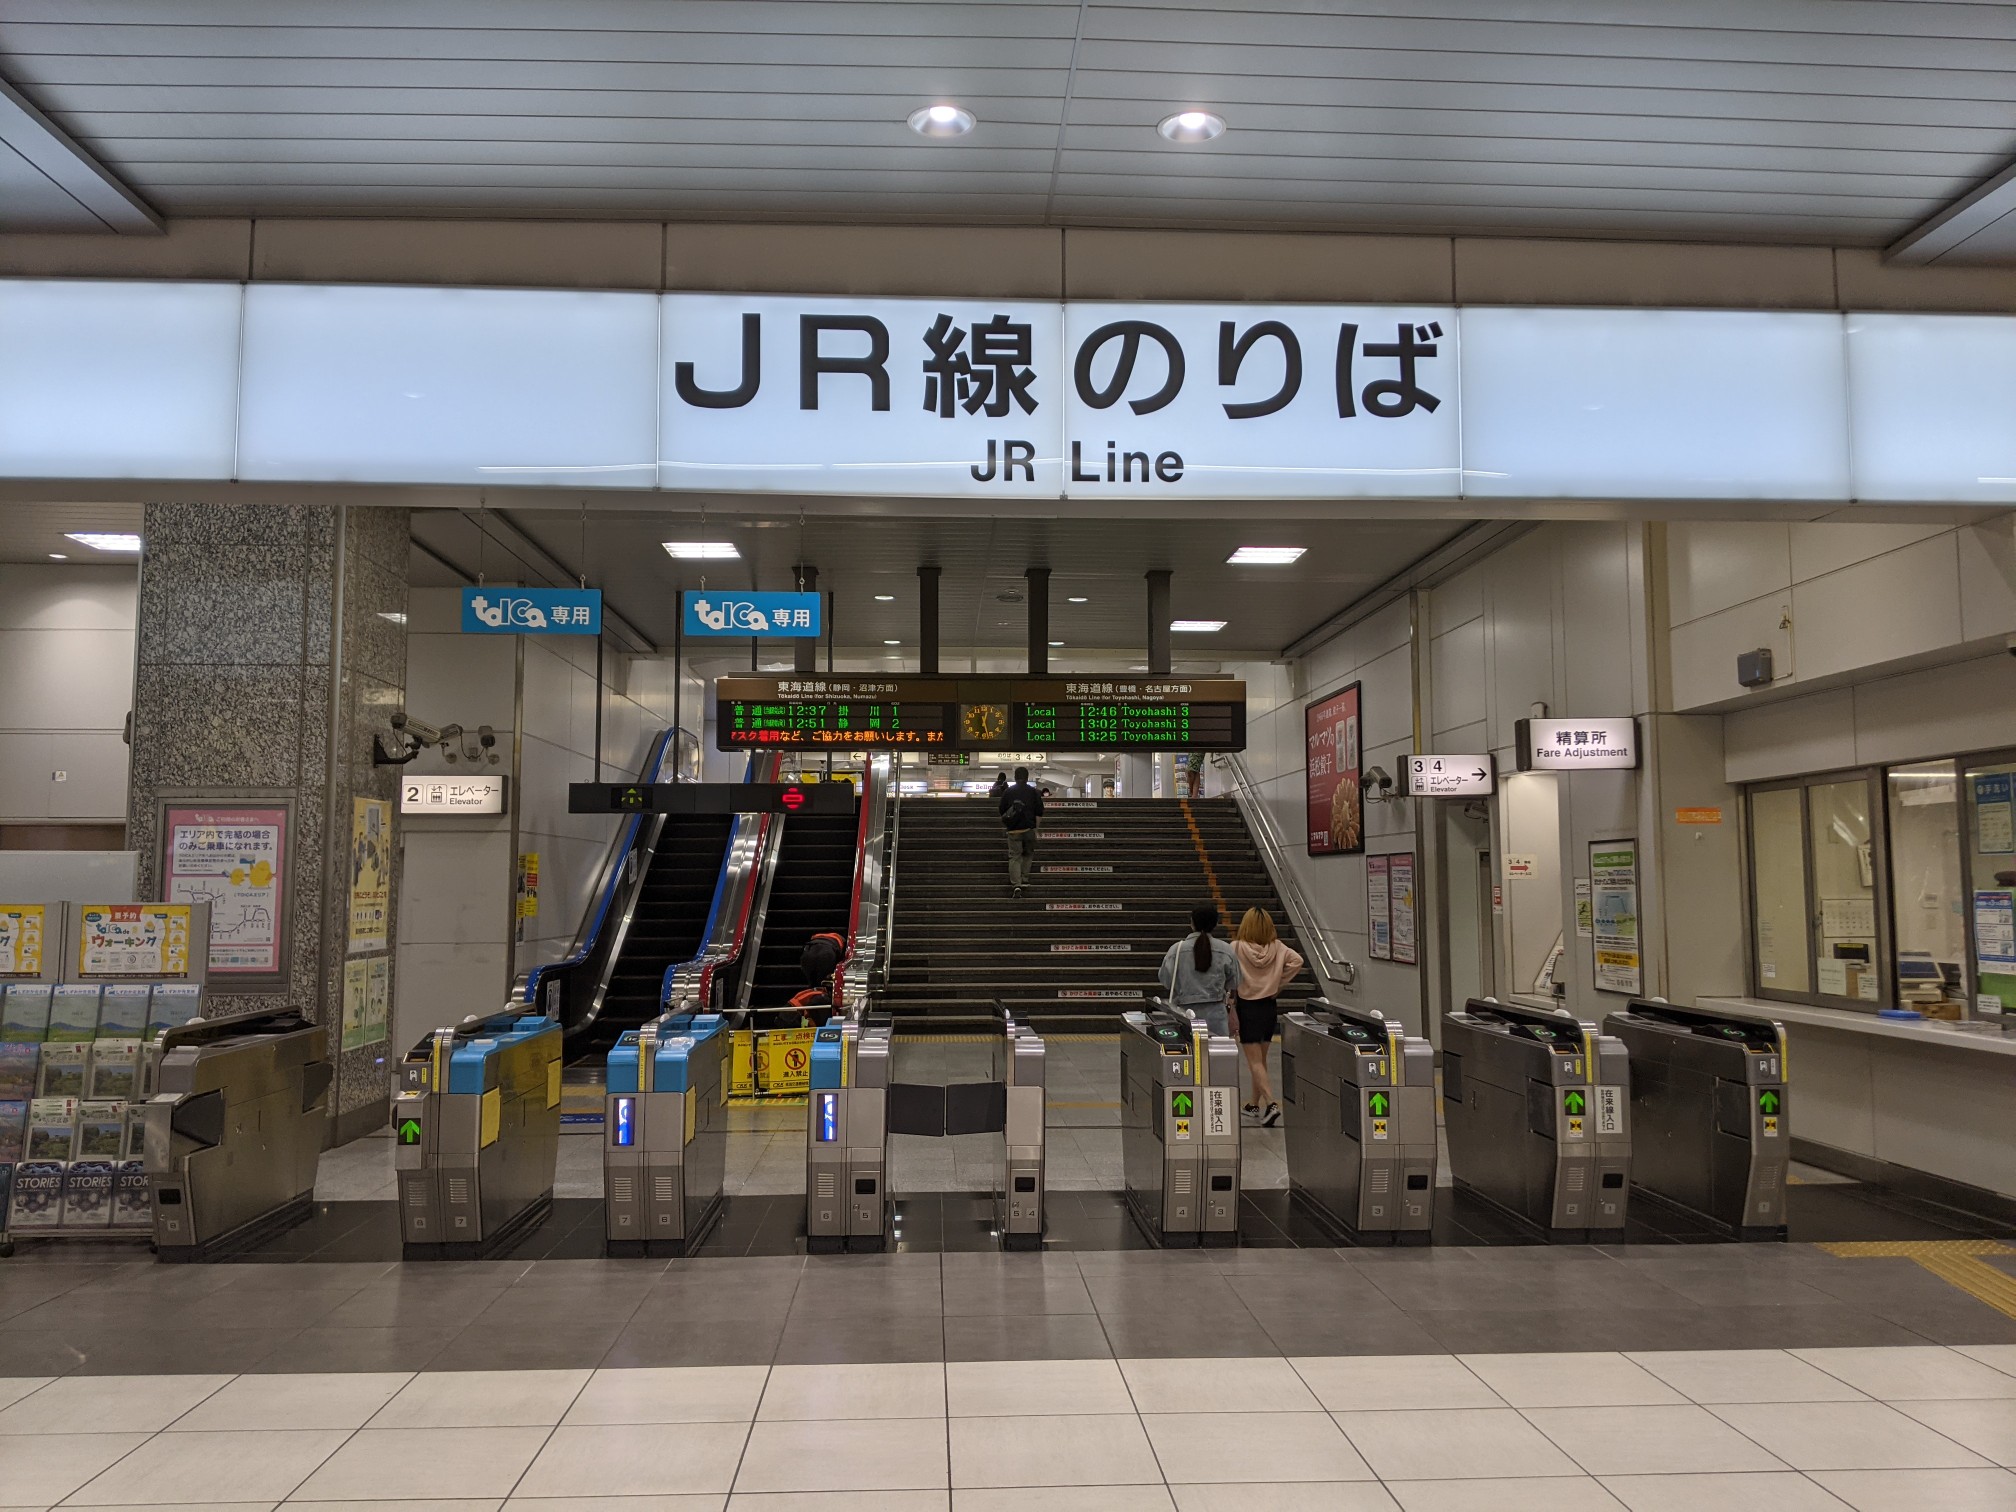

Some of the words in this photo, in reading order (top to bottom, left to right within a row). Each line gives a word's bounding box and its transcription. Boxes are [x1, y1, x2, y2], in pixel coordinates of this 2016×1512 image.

[674, 312, 1443, 420] JR線のりば
[970, 439, 1036, 482] JR
[1071, 441, 1185, 483] Line
[550, 606, 591, 625] 専用
[771, 608, 811, 627] 専用
[788, 705, 826, 716] 12:37
[892, 706, 898, 716] 1
[1027, 706, 1056, 717] Local
[1079, 706, 1117, 717] 12:46
[1121, 706, 1177, 718] Toyohashi
[1181, 706, 1189, 717] 3
[788, 718, 825, 729] 12:51
[892, 718, 900, 729] 2
[1027, 719, 1056, 729] Local
[1079, 719, 1117, 729] 13:02
[1121, 719, 1177, 730] Toyohashi
[1181, 719, 1189, 729] 3
[1027, 731, 1056, 742] Local
[1079, 731, 1117, 742] 13:25
[1121, 731, 1177, 743] Toyohashi
[1181, 731, 1189, 742] 3
[1556, 730, 1607, 746] 精算所
[1536, 748, 1561, 757] Fare
[1564, 747, 1628, 759] Adjustment
[1414, 760, 1424, 772] 3
[1433, 760, 1442, 772] 4
[1430, 776, 1468, 785] エレベーター
[407, 787, 419, 802] 2
[449, 785, 499, 796] エレベーター
[449, 797, 483, 805] Elevator
[91, 934, 157, 948] ウォーキング
[1213, 1090, 1223, 1133] 在来線入口
[1605, 1089, 1615, 1131] 在来線入口
[16, 1176, 61, 1189] STORIES
[69, 1176, 113, 1189] STORIES
[120, 1175, 149, 1188] STOR
